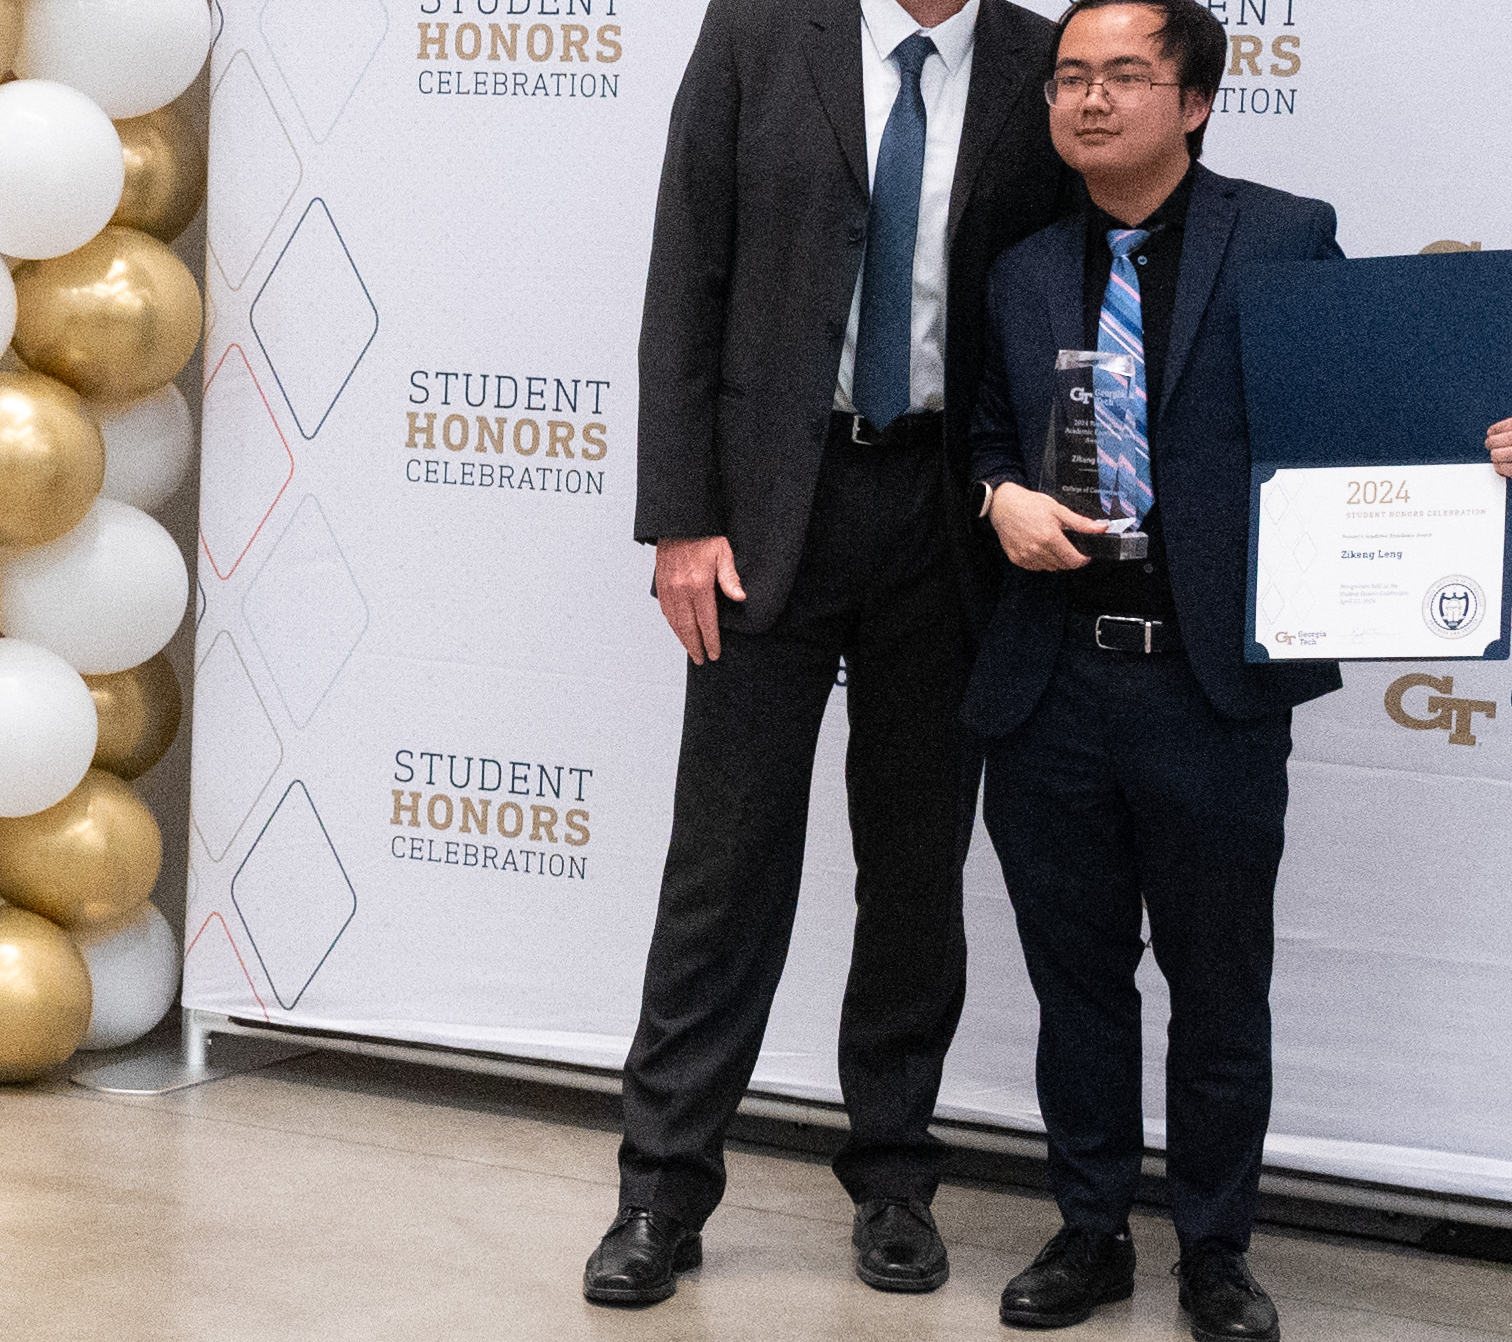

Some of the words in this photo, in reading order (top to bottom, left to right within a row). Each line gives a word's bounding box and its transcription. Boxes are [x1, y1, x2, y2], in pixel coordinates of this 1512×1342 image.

[418, 23, 622, 62] HONORS
[419, 71, 618, 98] CELEBRATION
[409, 370, 610, 414] STUDENT
[406, 412, 606, 460] HONORS
[407, 460, 604, 494] CELEBRATION
[1346, 480, 1411, 505] 2024
[1346, 511, 1386, 519] STUDENT
[1389, 510, 1424, 518] HONORS
[1427, 509, 1487, 517] CELEBRATION
[1341, 550, 1375, 561] Zikeng
[1378, 550, 1403, 560] Leng
[1385, 674, 1495, 745] GT
[395, 750, 593, 802] STUDENT
[392, 790, 590, 845] HONORS
[391, 838, 586, 880] CELEBRATION
